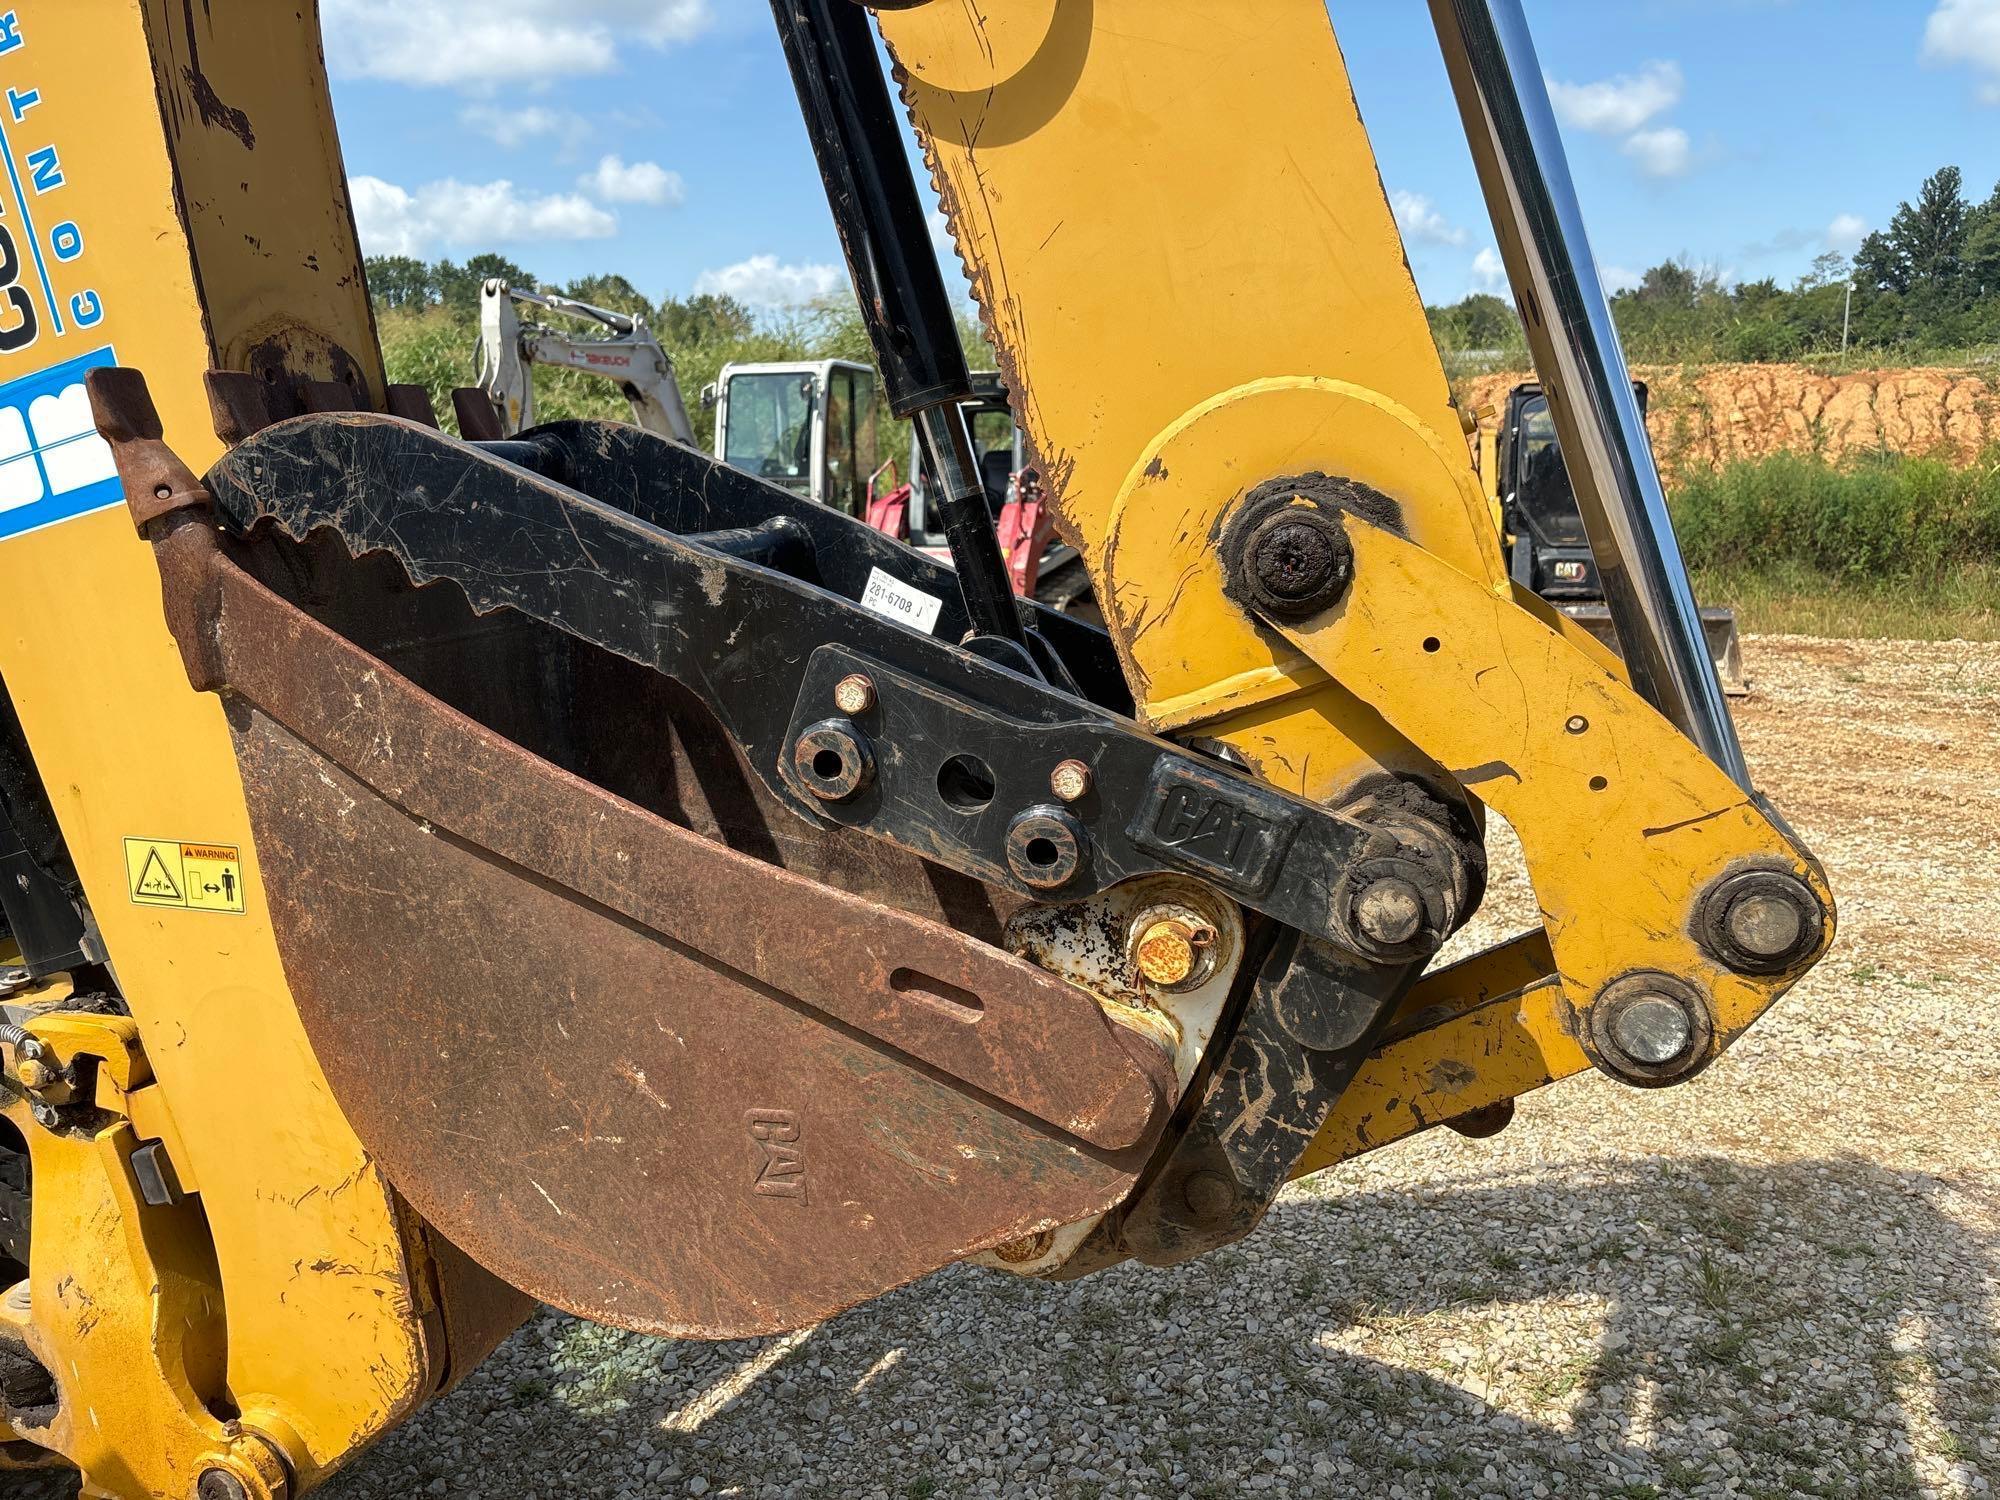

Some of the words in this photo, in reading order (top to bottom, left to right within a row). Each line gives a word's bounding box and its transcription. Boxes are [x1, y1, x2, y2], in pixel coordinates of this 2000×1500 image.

[1555, 561, 1579, 577] CAT
[869, 581, 913, 613] 281-6708
[916, 606, 923, 618] J
[1154, 785, 1276, 877] CAT
[194, 848, 236, 860] WARNING
